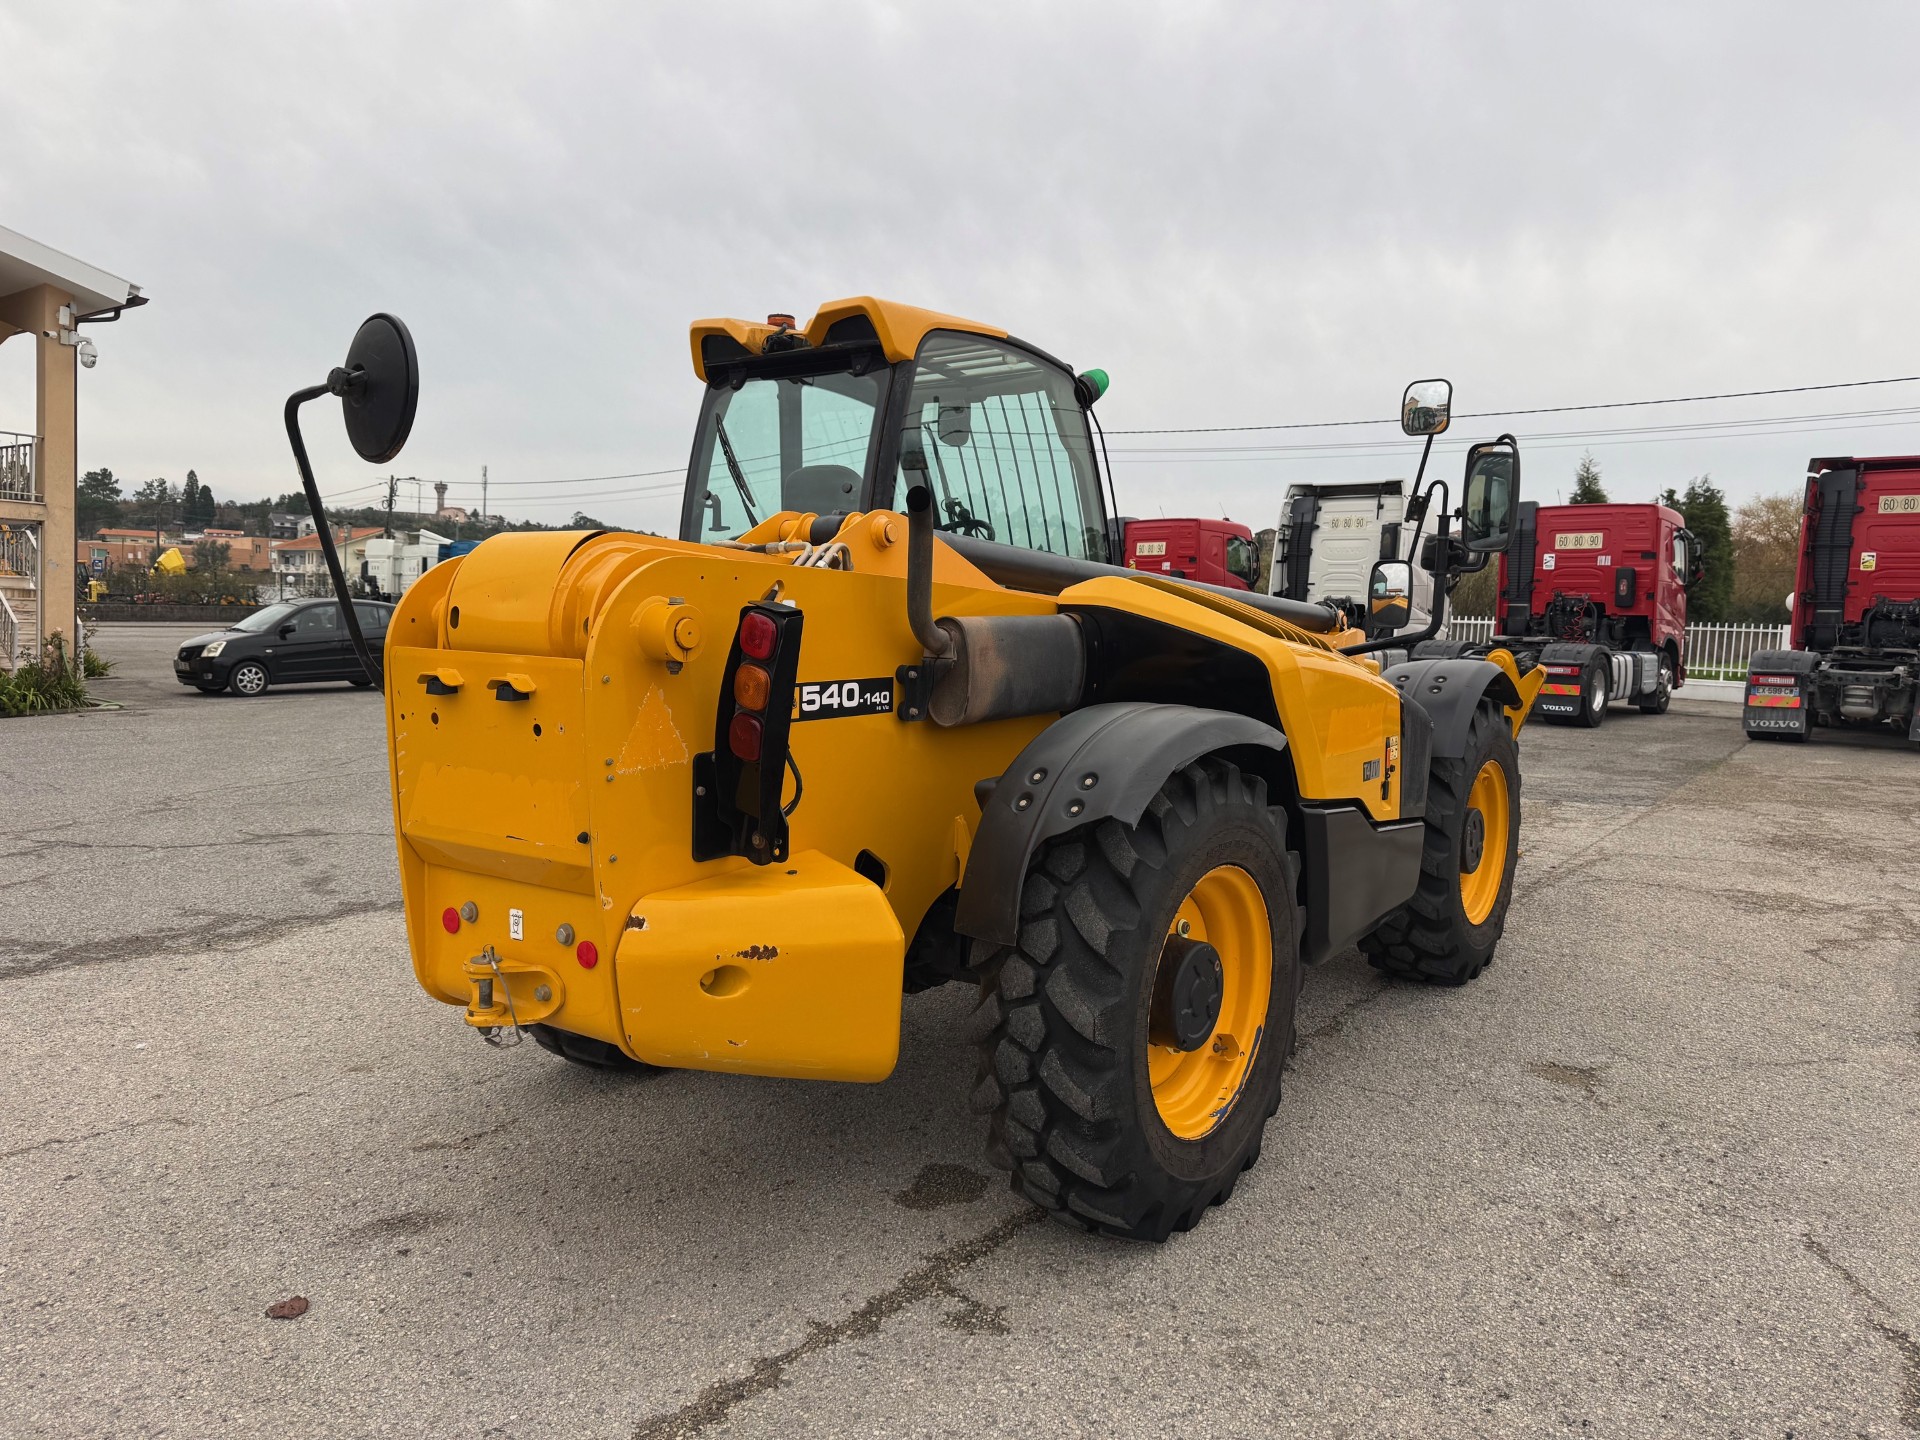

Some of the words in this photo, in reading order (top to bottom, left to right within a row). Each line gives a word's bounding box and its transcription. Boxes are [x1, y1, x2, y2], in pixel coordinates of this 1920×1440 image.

[1883, 499, 1895, 511] 60
[1903, 498, 1916, 510] 80
[1558, 536, 1569, 547] 60
[1573, 535, 1584, 547] 80
[1589, 535, 1599, 546] 90
[1542, 704, 1573, 712] VOLVO
[1747, 719, 1800, 728] VOLVO
